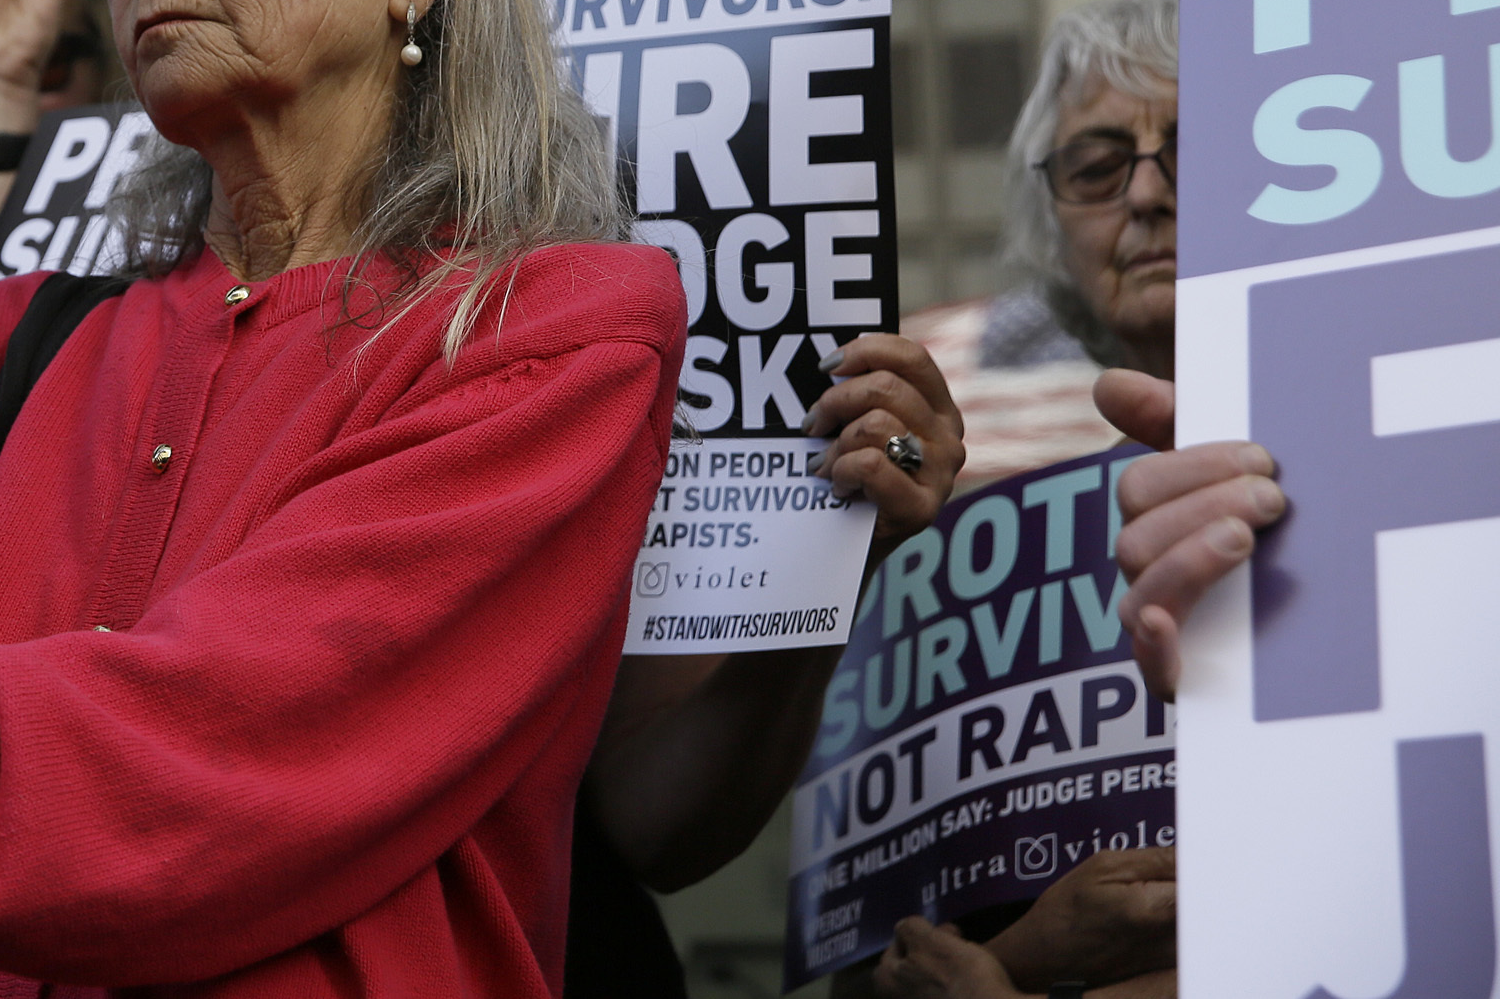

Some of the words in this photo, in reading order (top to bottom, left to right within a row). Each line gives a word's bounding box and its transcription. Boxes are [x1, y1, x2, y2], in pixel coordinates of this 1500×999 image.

[643, 522, 760, 548] APISTS.
[674, 566, 770, 590] violet
[642, 606, 839, 641] #STANDWITHSURVIVORS
[812, 726, 938, 850] NOT
[957, 673, 1177, 782] RAPI
[853, 819, 937, 881] MILLION
[940, 798, 993, 838] SAY:
[998, 773, 1094, 818] JUDGE
[921, 854, 1007, 903] ultra
